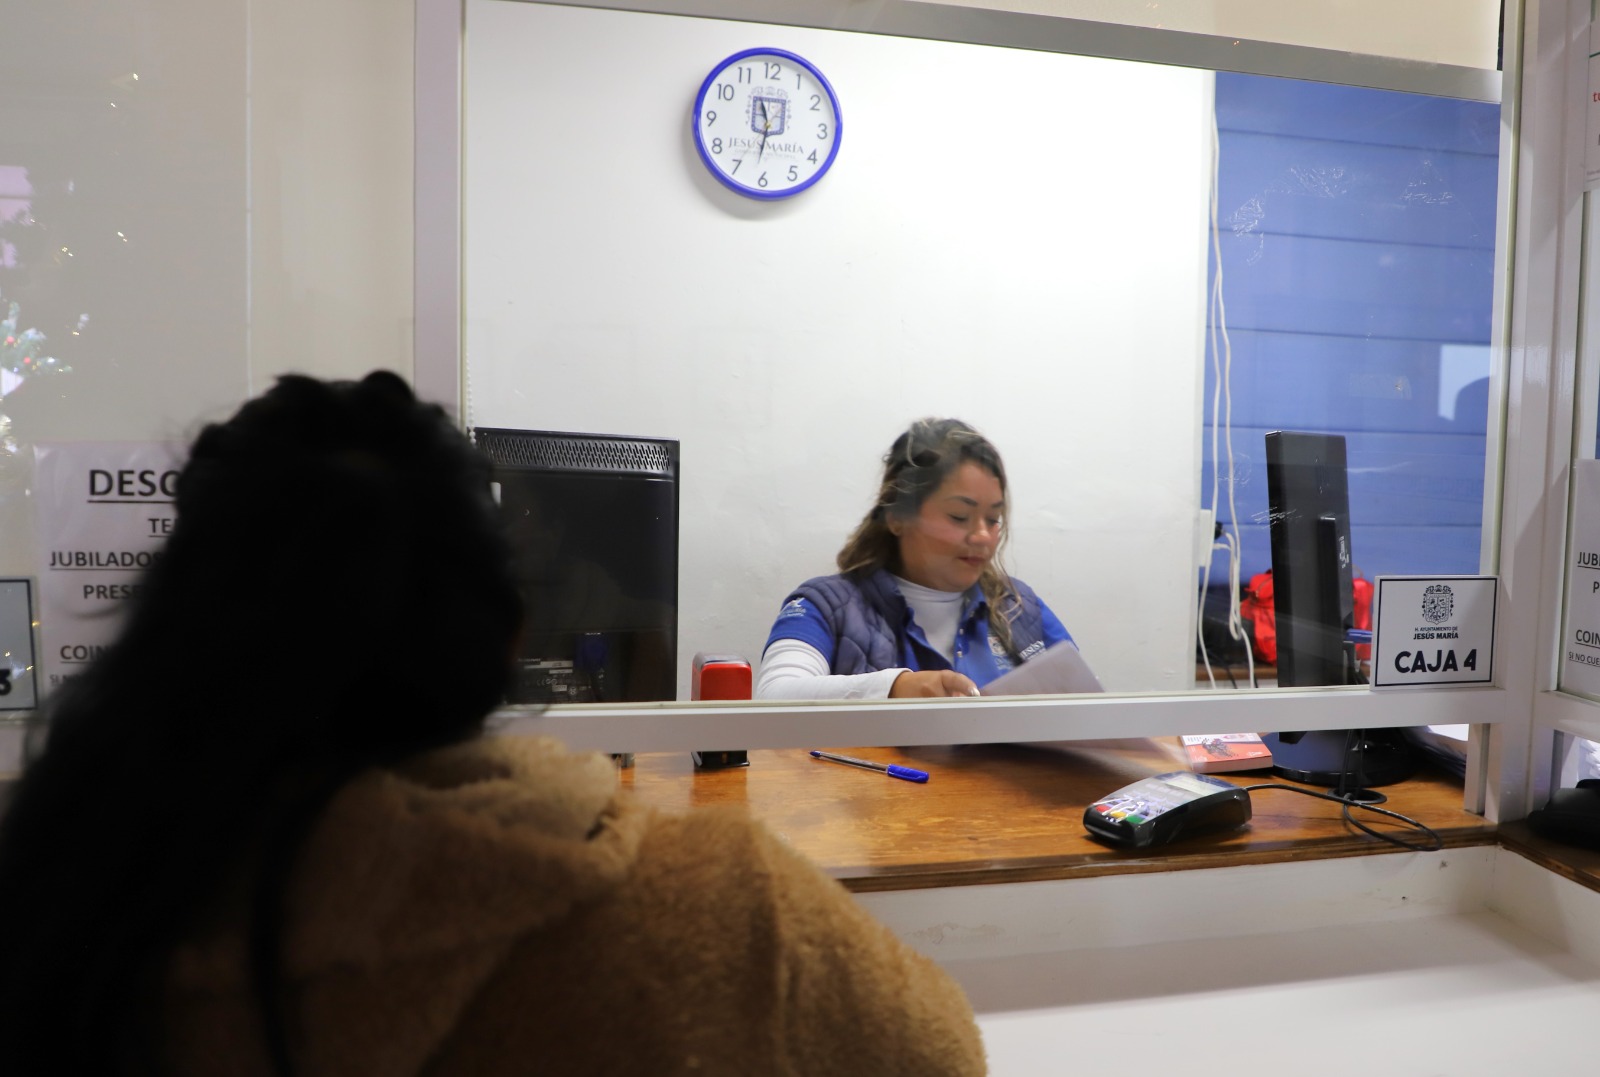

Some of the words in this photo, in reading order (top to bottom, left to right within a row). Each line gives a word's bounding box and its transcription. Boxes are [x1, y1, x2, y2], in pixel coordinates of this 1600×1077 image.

[738, 66, 751, 84] 11
[764, 62, 781, 80] 12
[796, 73, 801, 90] 1
[717, 83, 734, 101] 10
[809, 94, 821, 111] 2
[706, 110, 717, 127] 9
[816, 123, 828, 139] 3
[711, 137, 722, 154] 8
[806, 148, 818, 165] 4
[732, 159, 742, 175] 7
[787, 165, 798, 182] 5
[757, 171, 768, 188] 6
[148, 518, 178, 534] TE
[1413, 631, 1435, 640] JESÚS
[1436, 631, 1458, 639] MARÍA
[1395, 649, 1458, 673] CAJA
[1464, 649, 1477, 671] 4
[1575, 653, 1585, 661] NO
